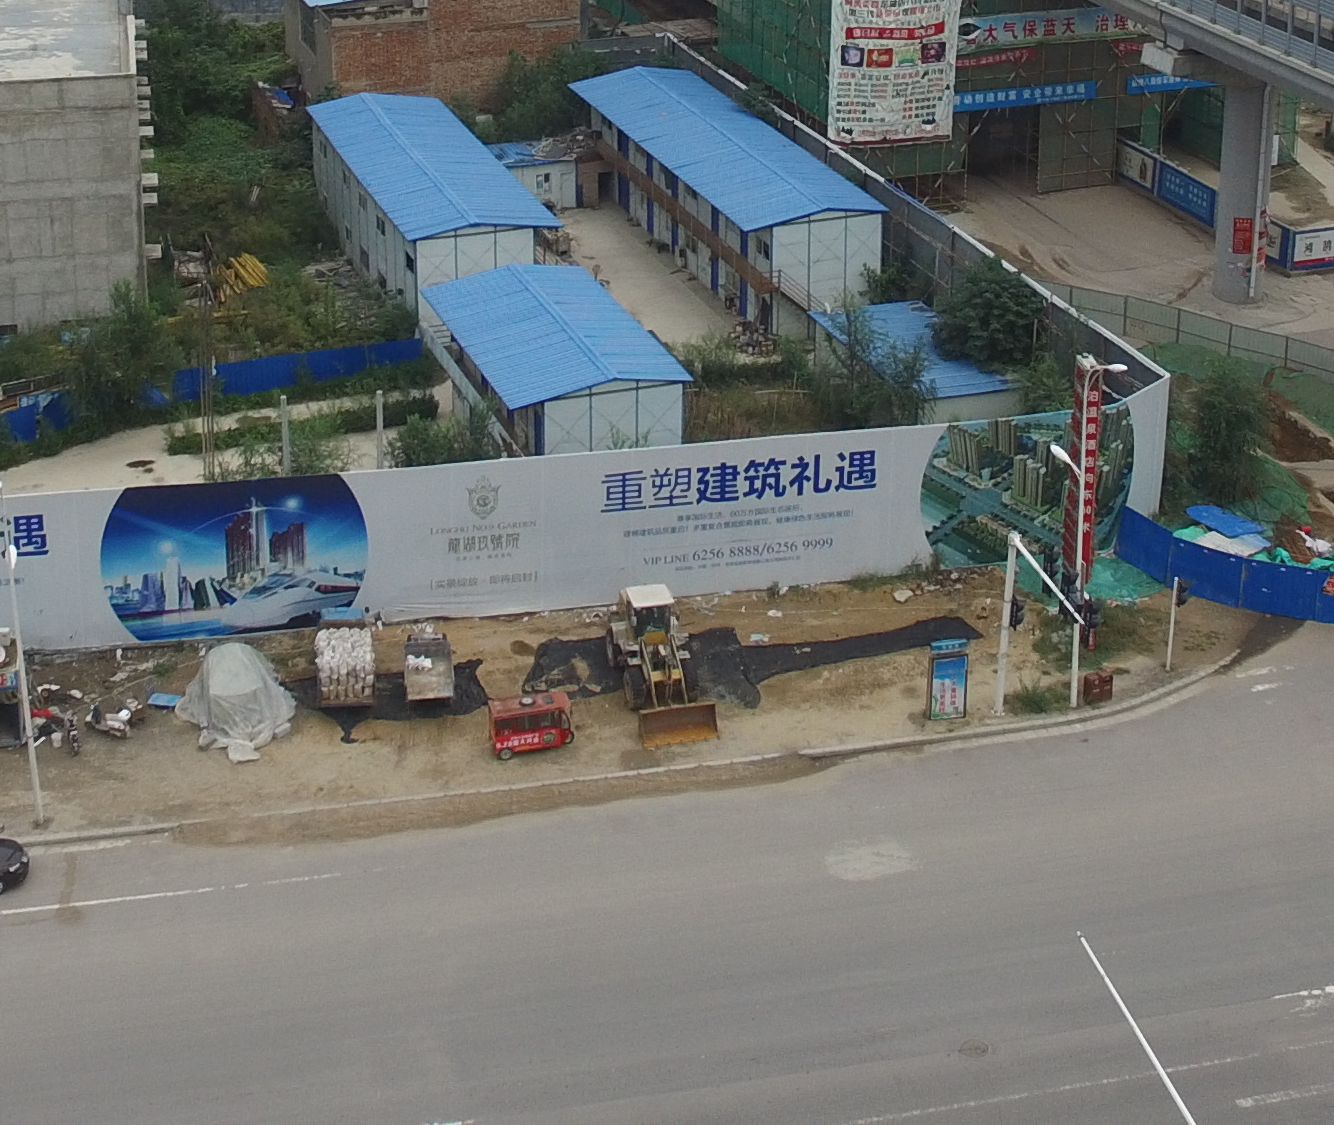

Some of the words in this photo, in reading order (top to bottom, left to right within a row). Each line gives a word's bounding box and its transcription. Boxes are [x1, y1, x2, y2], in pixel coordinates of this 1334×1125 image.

[600, 450, 877, 513] 重塑建筑礼遇
[643, 556, 662, 566] VIP
[664, 553, 689, 564] LINE
[692, 548, 725, 562] 6256
[729, 540, 798, 558] 8888/6256
[802, 537, 834, 550] 9999
